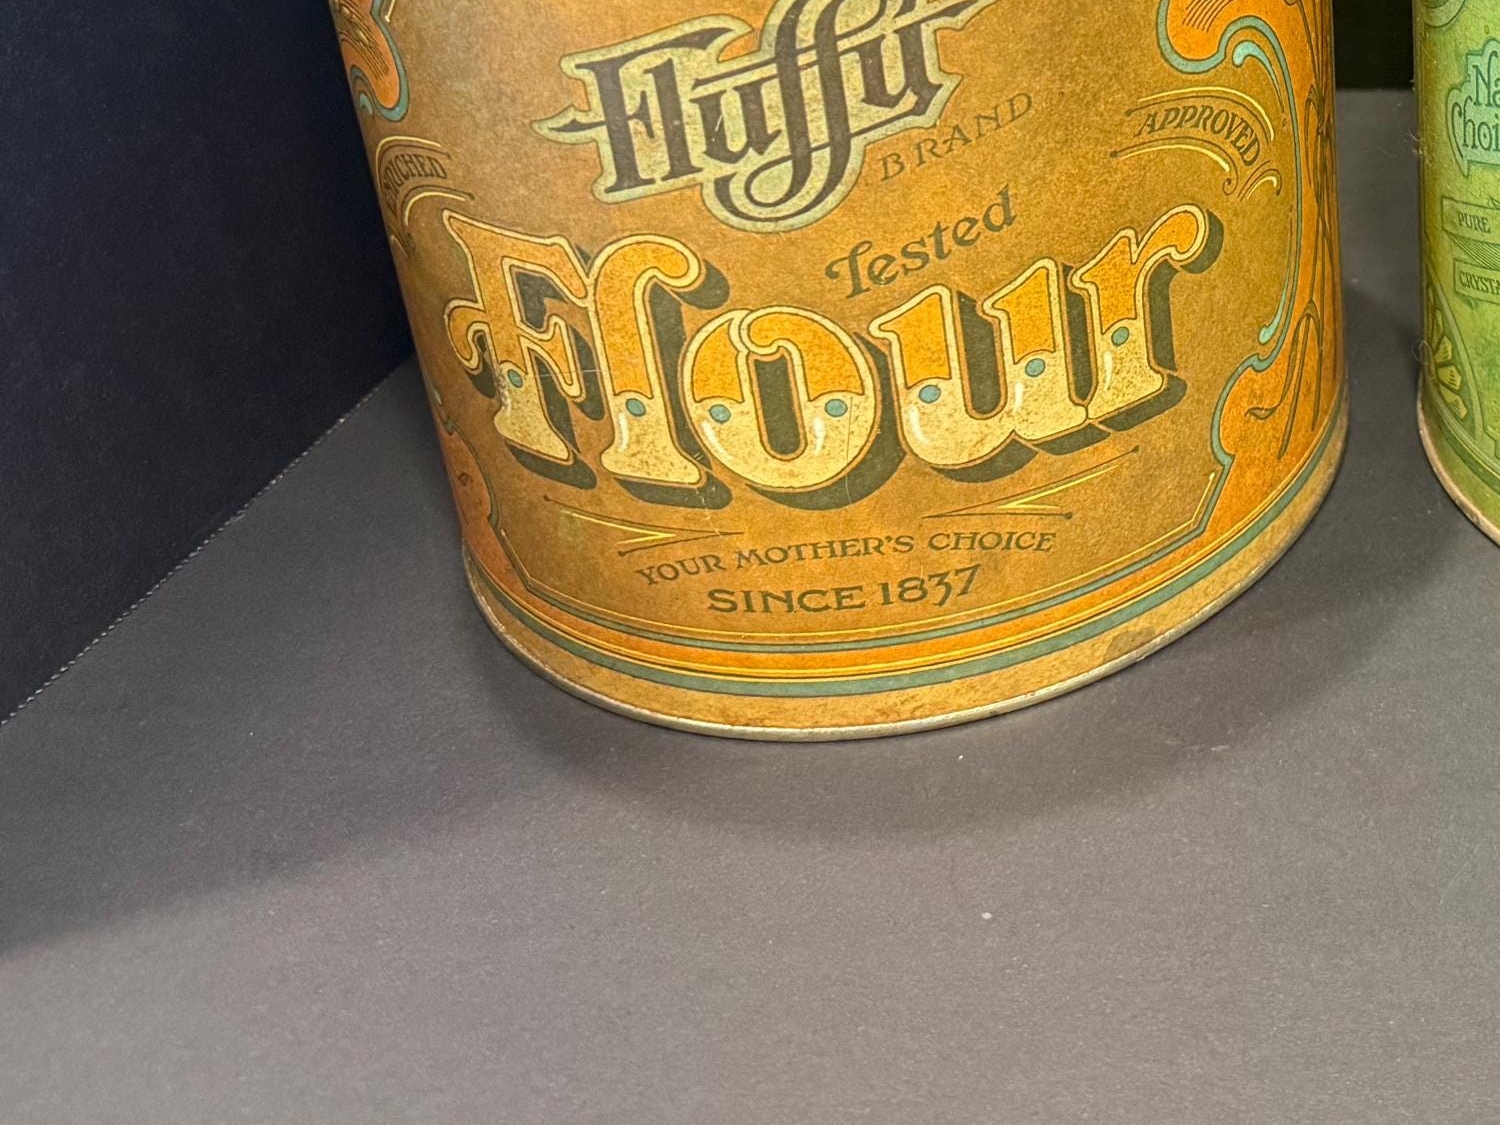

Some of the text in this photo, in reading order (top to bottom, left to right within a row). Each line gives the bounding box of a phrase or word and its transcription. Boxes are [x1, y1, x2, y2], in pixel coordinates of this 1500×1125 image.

[878, 92, 1033, 182] BRAND
[1134, 104, 1261, 167] APPROVED
[825, 184, 1017, 299] Tested
[1457, 211, 1492, 234] PURE
[444, 203, 1222, 508] Flour
[636, 531, 1057, 585] YOUR MOTHER'S CHOICE
[707, 564, 982, 613] SINCE 1837
